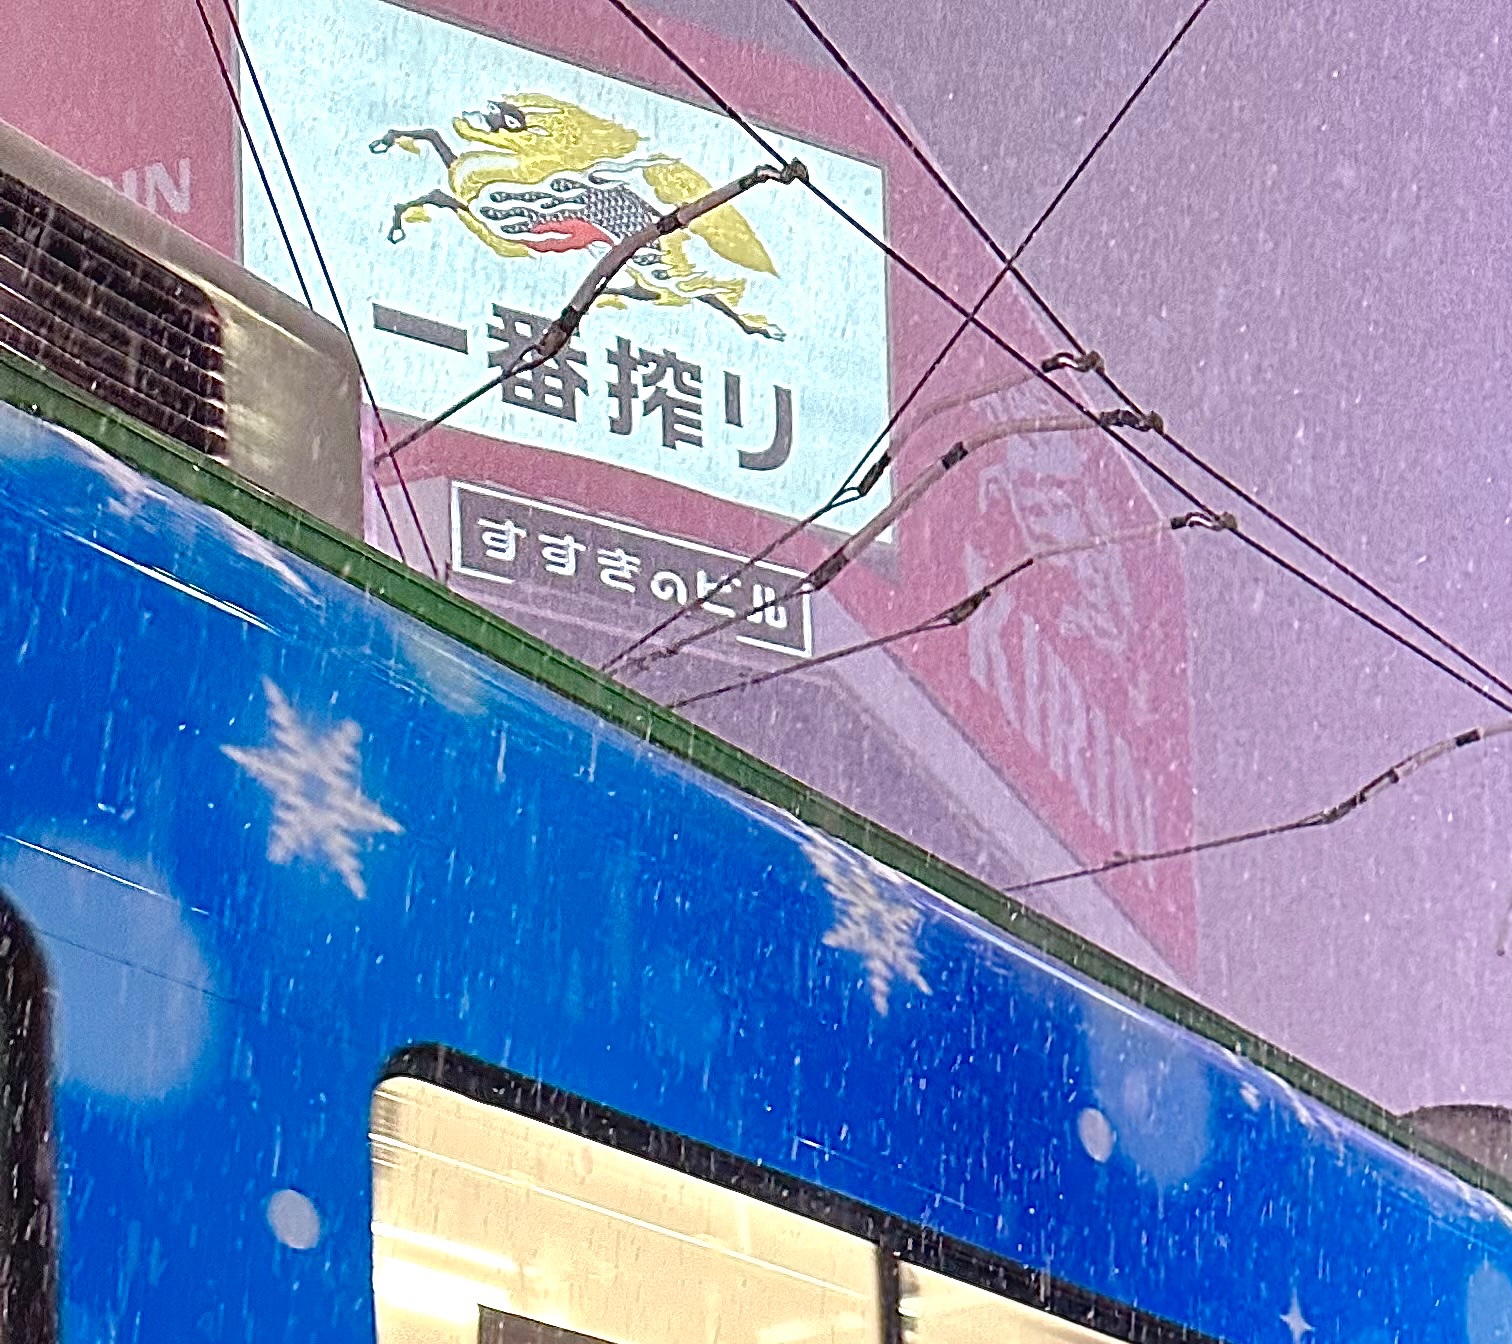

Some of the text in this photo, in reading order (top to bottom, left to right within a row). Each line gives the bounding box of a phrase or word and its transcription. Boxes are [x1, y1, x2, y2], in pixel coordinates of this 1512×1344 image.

[372, 301, 794, 472] 一番搾り
[476, 517, 789, 629] すすきのビル
